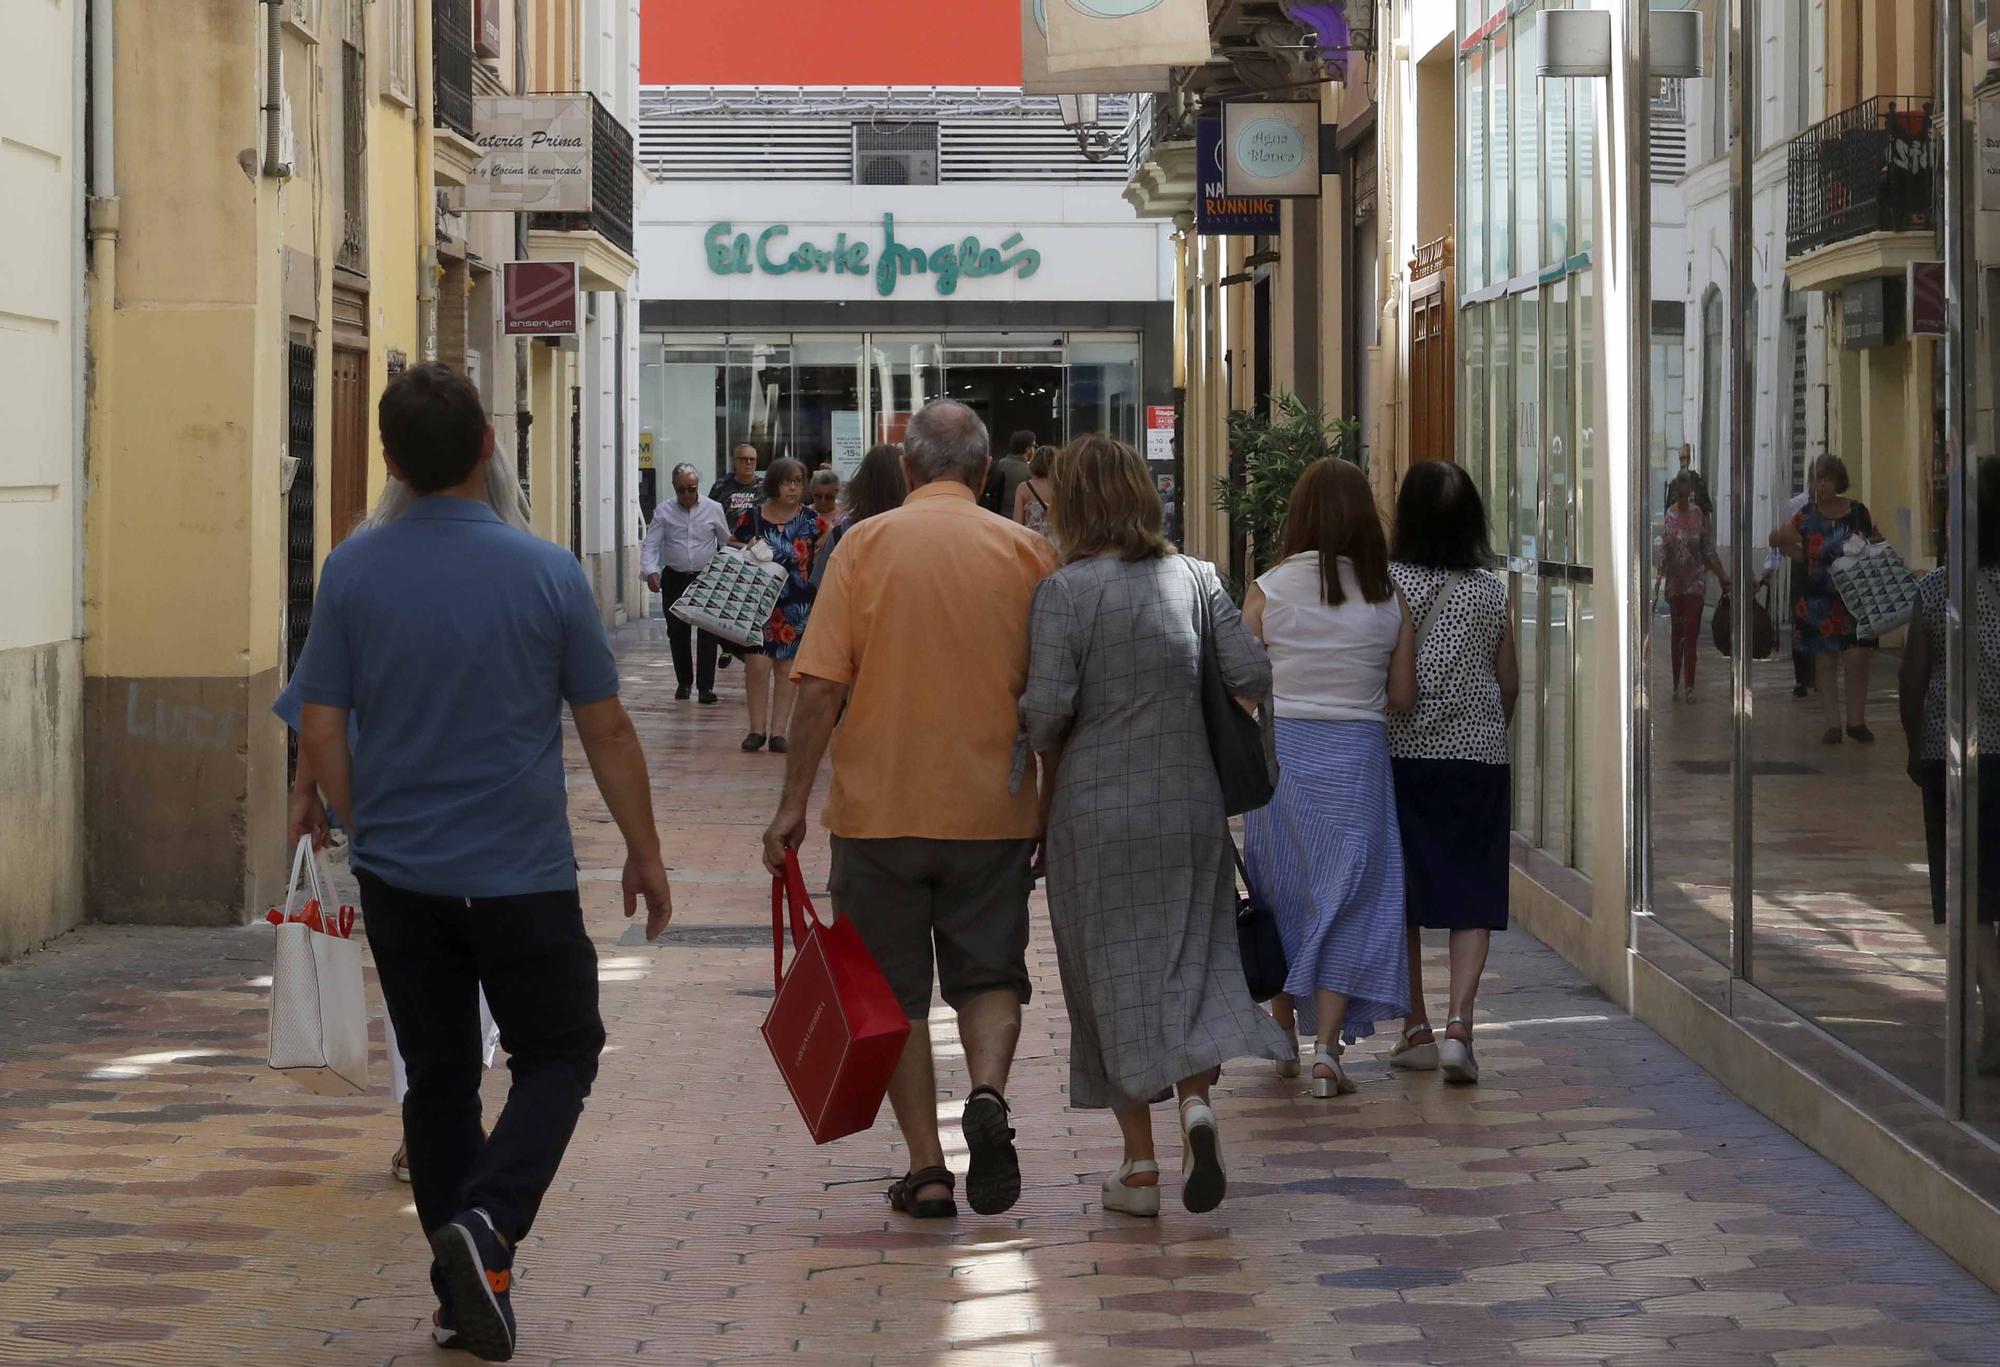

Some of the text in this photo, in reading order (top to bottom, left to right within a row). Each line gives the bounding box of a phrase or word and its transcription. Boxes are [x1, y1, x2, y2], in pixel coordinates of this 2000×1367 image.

[530, 131, 583, 149] Prima
[1253, 132, 1288, 146] Agua
[1247, 149, 1295, 162] Blanca
[480, 167, 486, 177] y
[491, 163, 524, 177] Cocina
[528, 166, 538, 175] de
[542, 165, 582, 176] mercado
[1206, 199, 1275, 215] RUNNING
[704, 212, 1041, 297] El Corte Inglés
[510, 320, 572, 328] ensenyem
